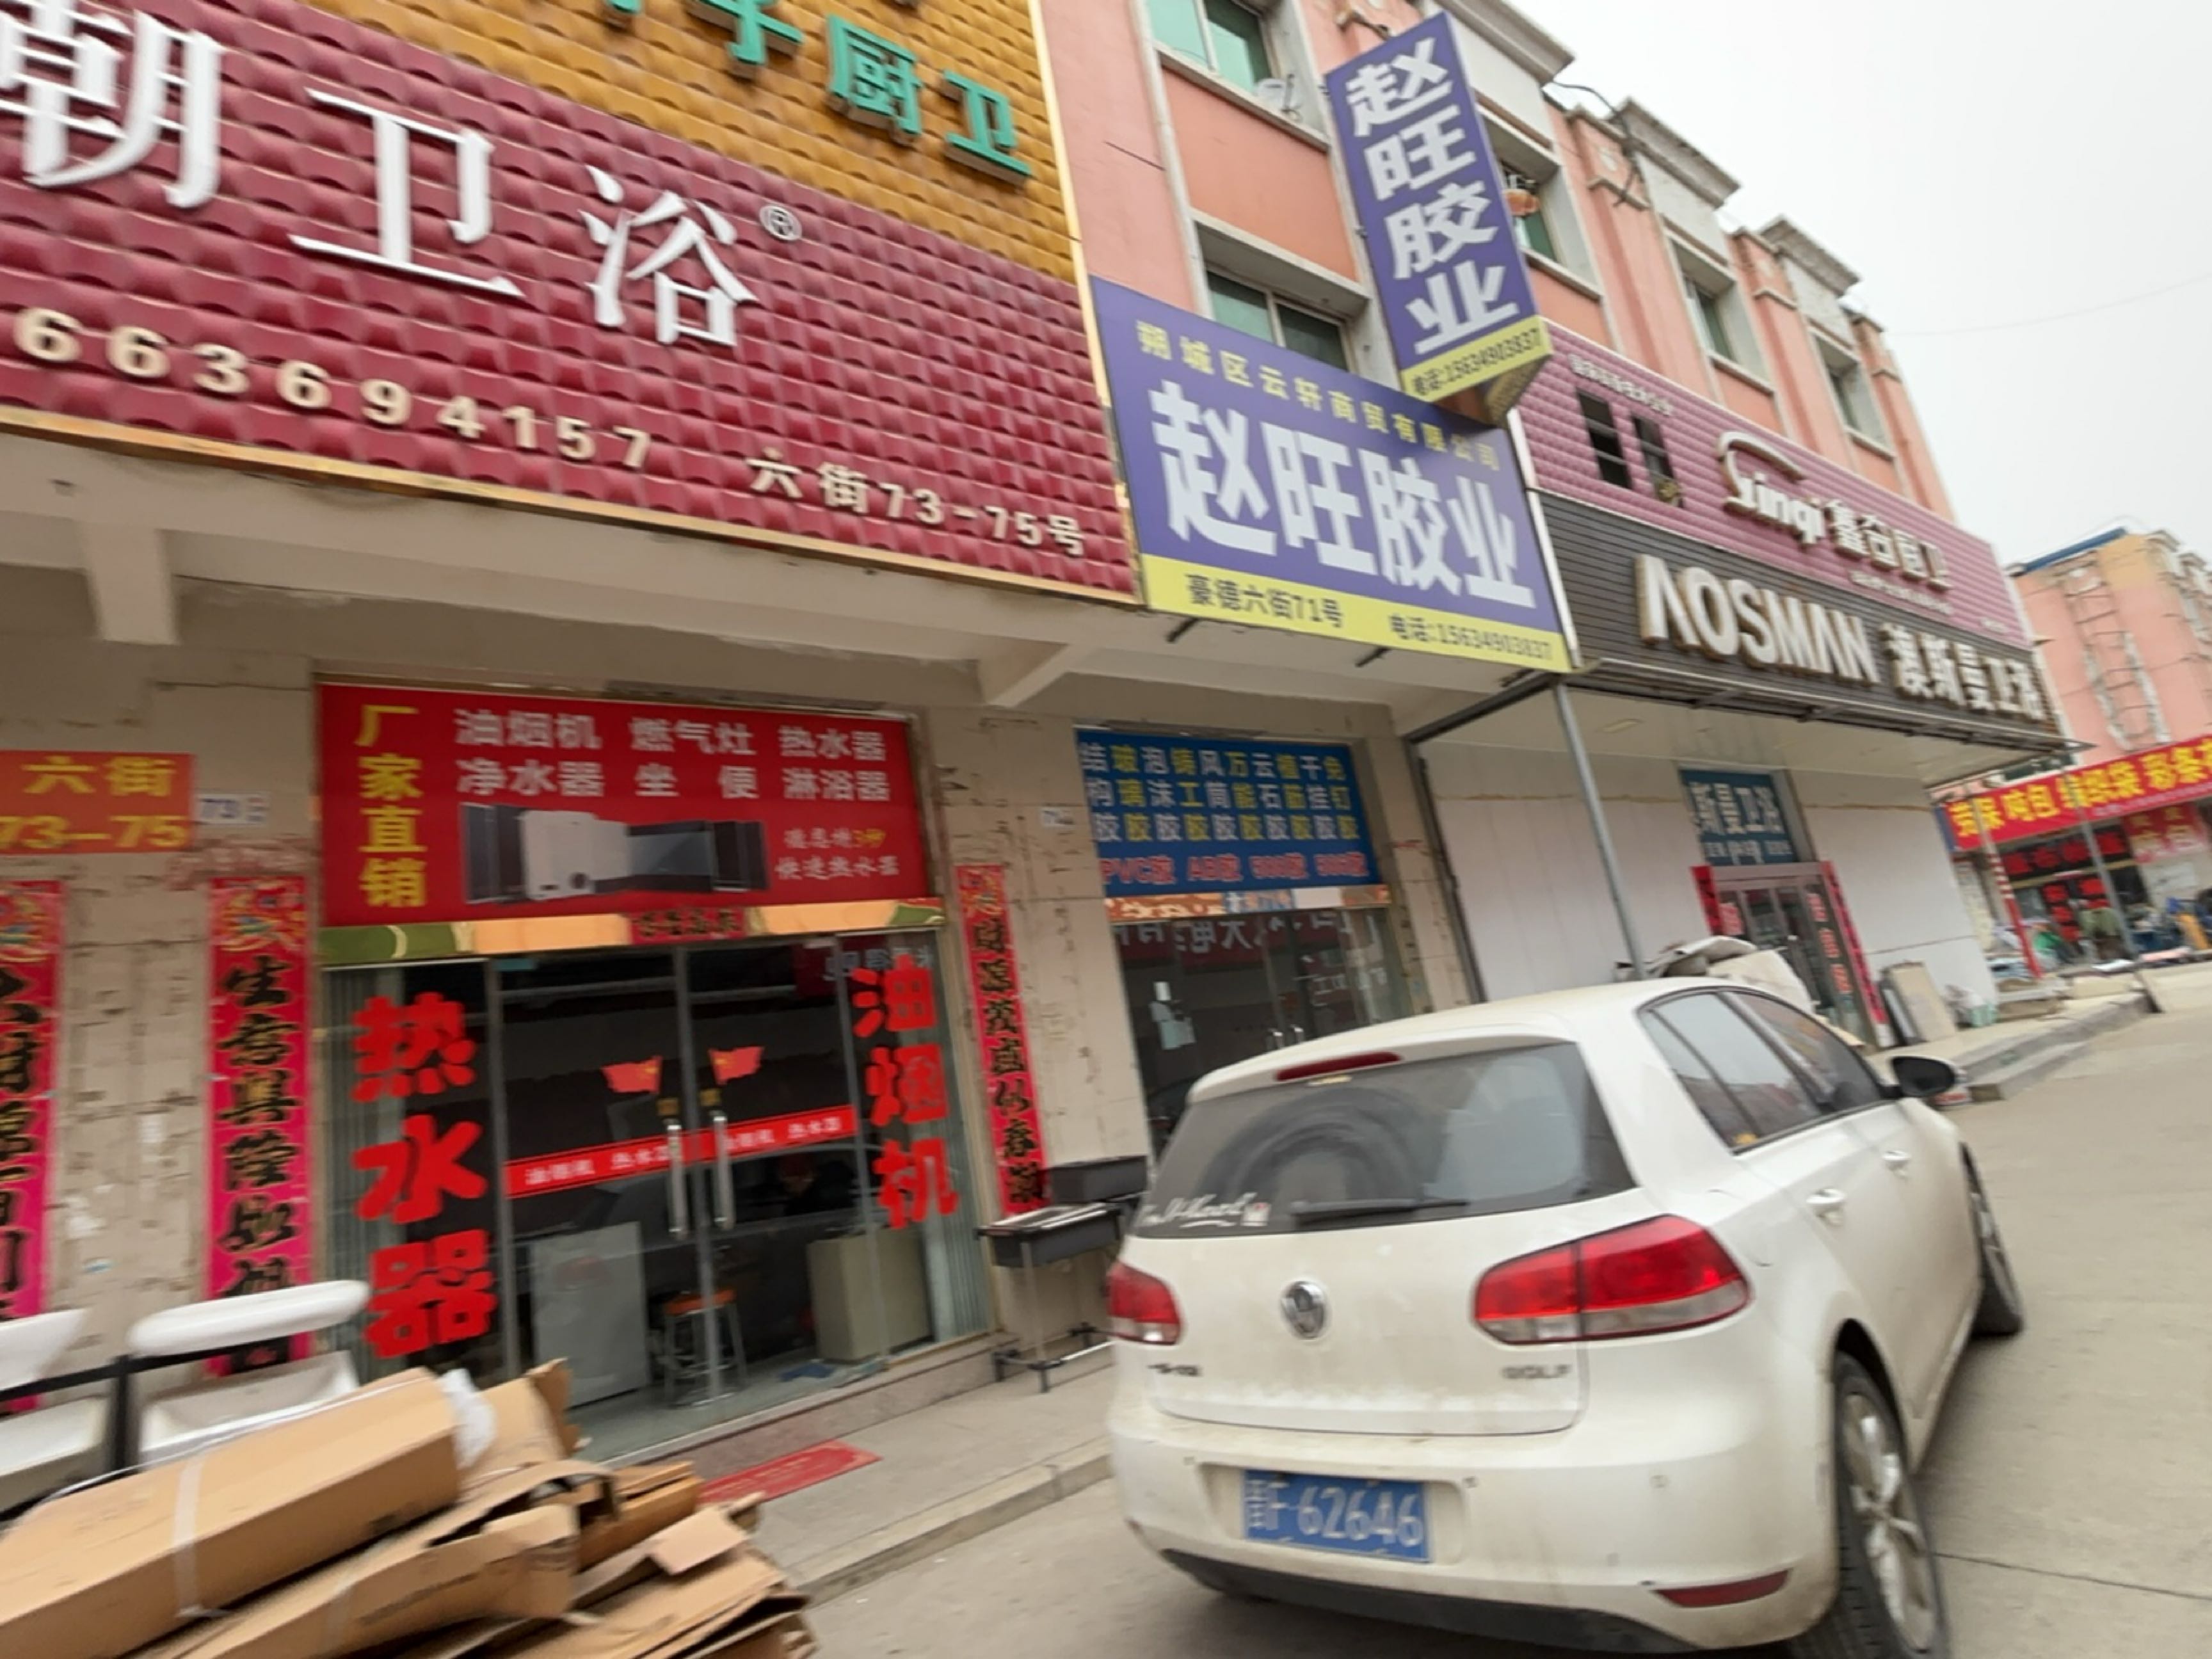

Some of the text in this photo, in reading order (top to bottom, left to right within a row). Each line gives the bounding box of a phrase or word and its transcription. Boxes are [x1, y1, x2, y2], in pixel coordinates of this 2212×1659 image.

[1345, 38, 1519, 355] 赵旺胶业
[13, 307, 1085, 556] 663694157 六街73-75号
[1137, 321, 1500, 470] 朔城区云轩商贸有限公司
[1148, 380, 1536, 609] 赵旺胶业
[1186, 573, 1343, 627] 豪德六街71号
[1635, 554, 1880, 684] AOSMAN
[22, 755, 177, 797] 六街
[353, 705, 428, 908] 厂家直销
[454, 709, 886, 761] 油烟机 燃气灶 热水器
[456, 758, 605, 796] 净水器
[783, 767, 890, 801] 淋浴器
[351, 991, 497, 1358] 热水器
[853, 953, 960, 1229] 油烟机
